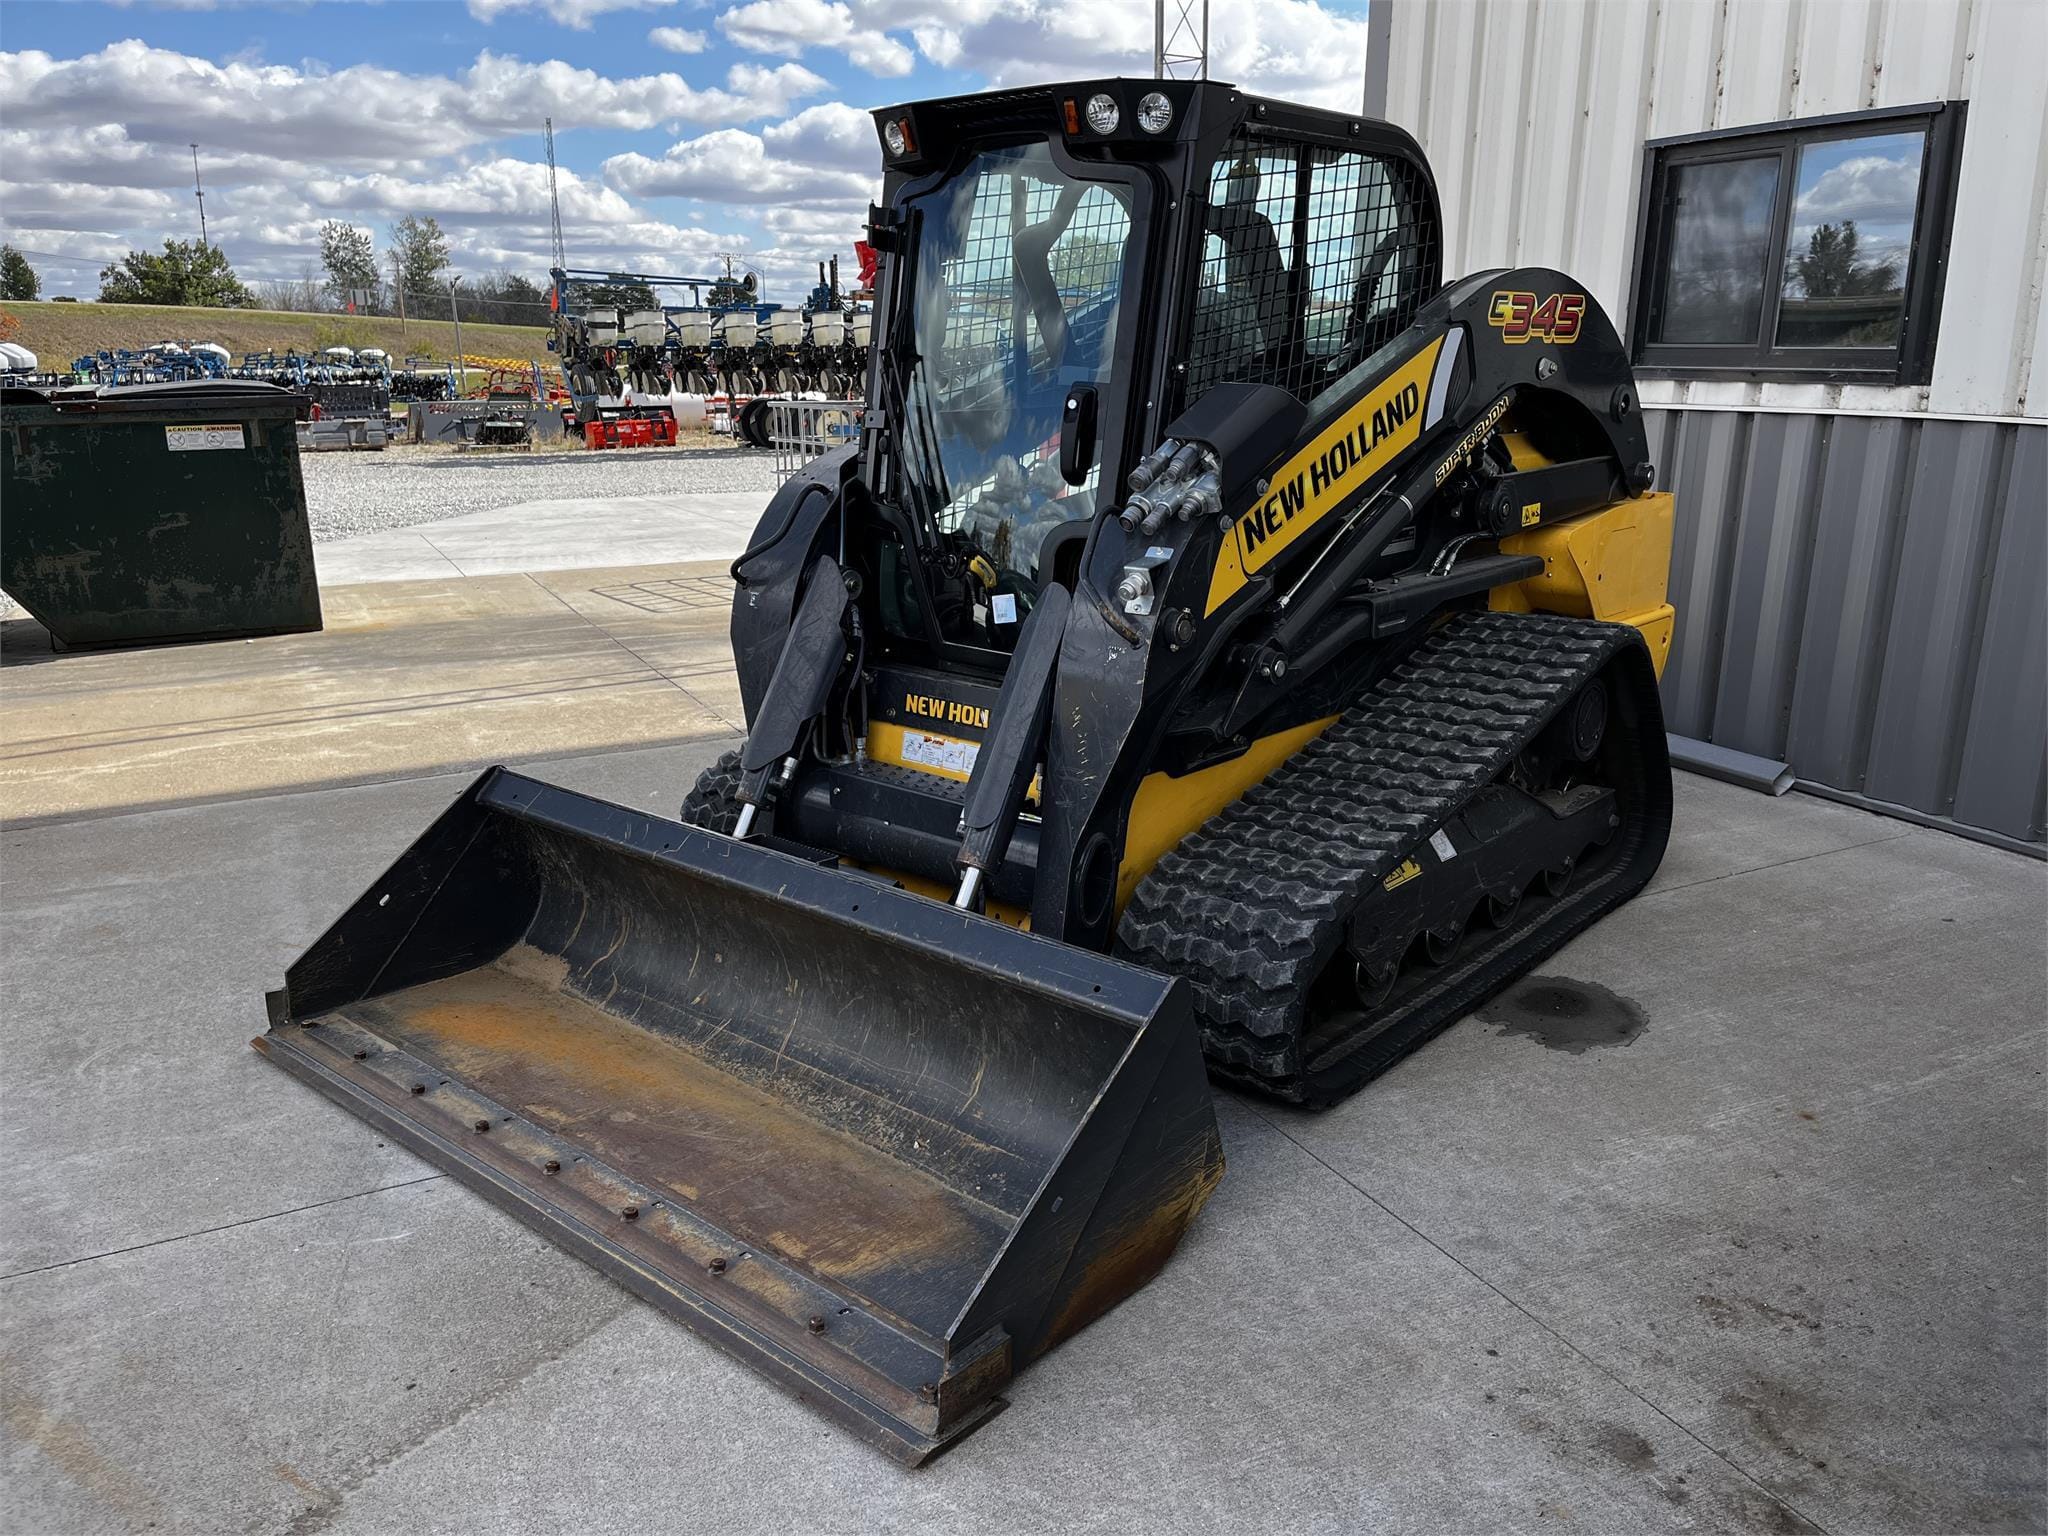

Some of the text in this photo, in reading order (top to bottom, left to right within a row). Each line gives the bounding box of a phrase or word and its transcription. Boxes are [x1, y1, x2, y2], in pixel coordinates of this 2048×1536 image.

[1488, 290, 1585, 344] C345
[1242, 381, 1419, 555] NEW HOLLAND
[905, 693, 946, 719] NEW
